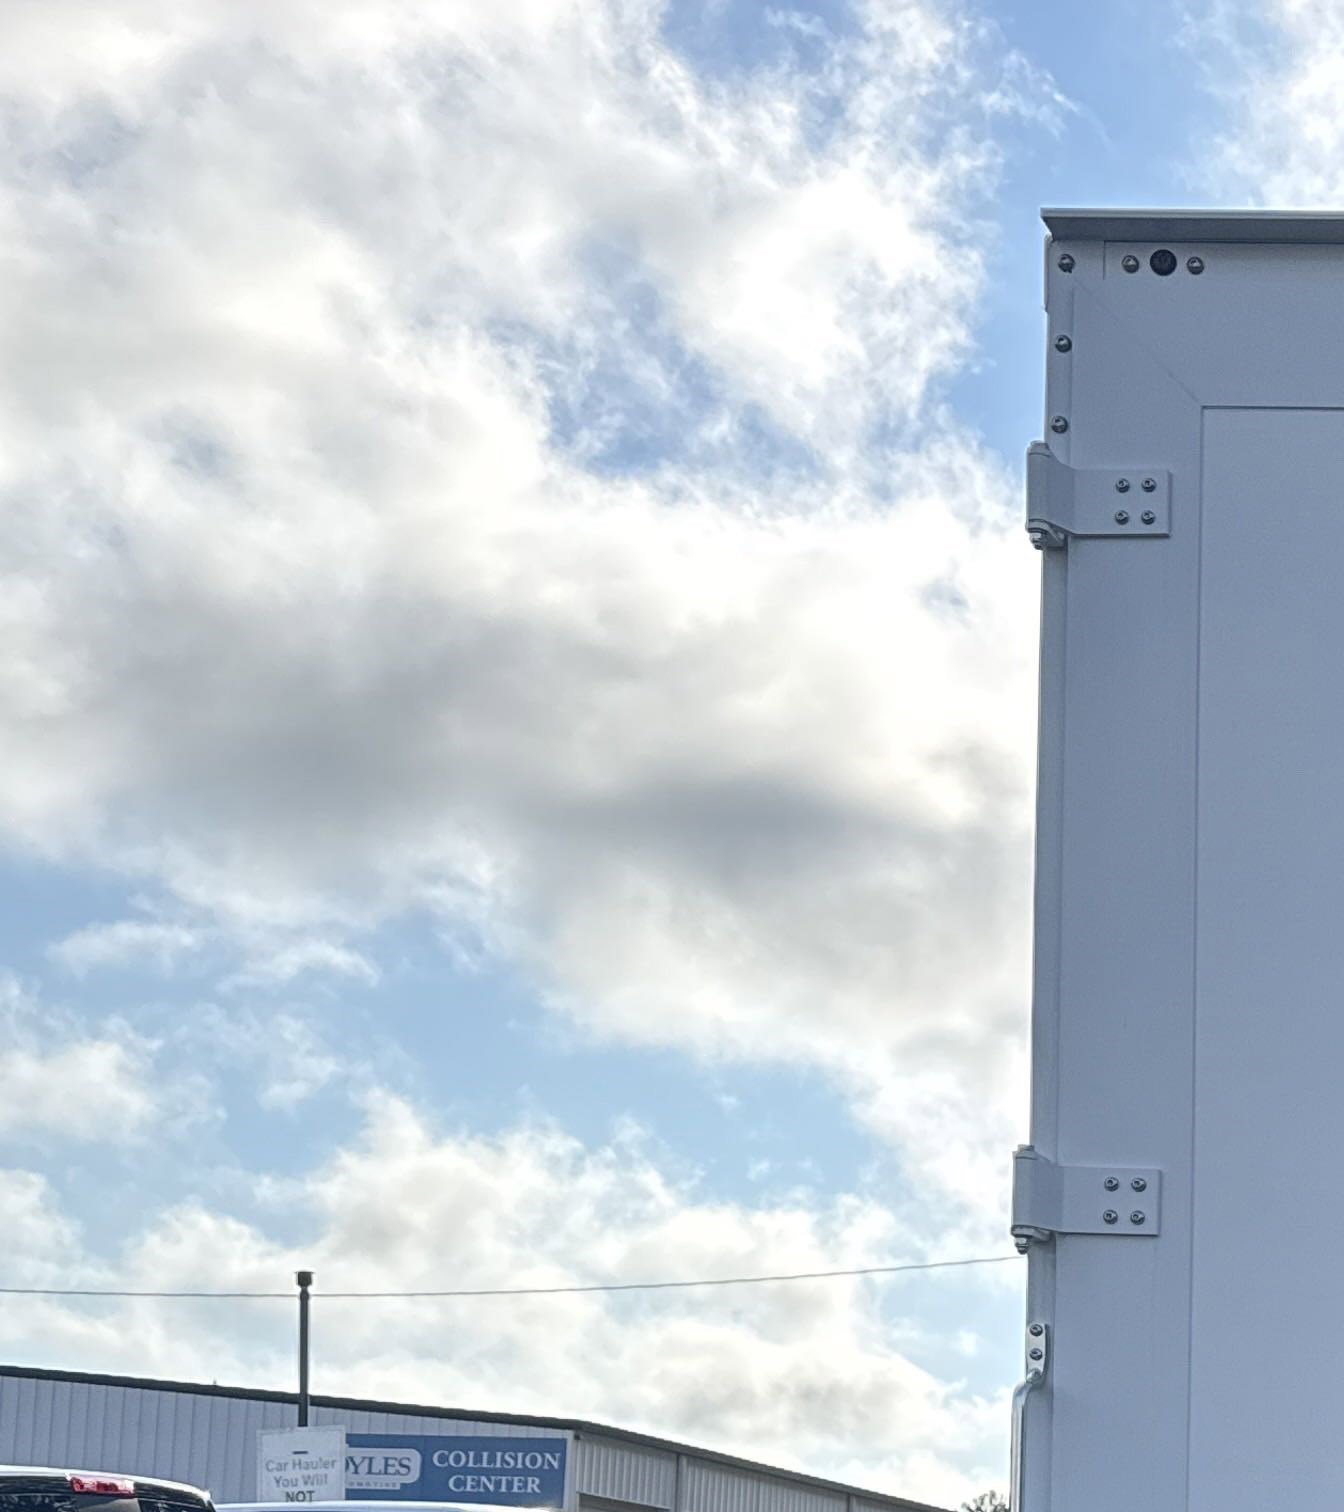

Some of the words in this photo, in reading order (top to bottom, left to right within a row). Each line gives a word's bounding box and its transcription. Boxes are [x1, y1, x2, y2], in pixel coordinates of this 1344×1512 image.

[265, 1459, 289, 1473] Car
[292, 1457, 337, 1472] Hauler
[345, 1455, 412, 1477] YLES
[432, 1449, 560, 1470] COLLISION
[274, 1475, 298, 1489] You
[448, 1474, 541, 1494] CENTER
[285, 1490, 315, 1503] NOT
